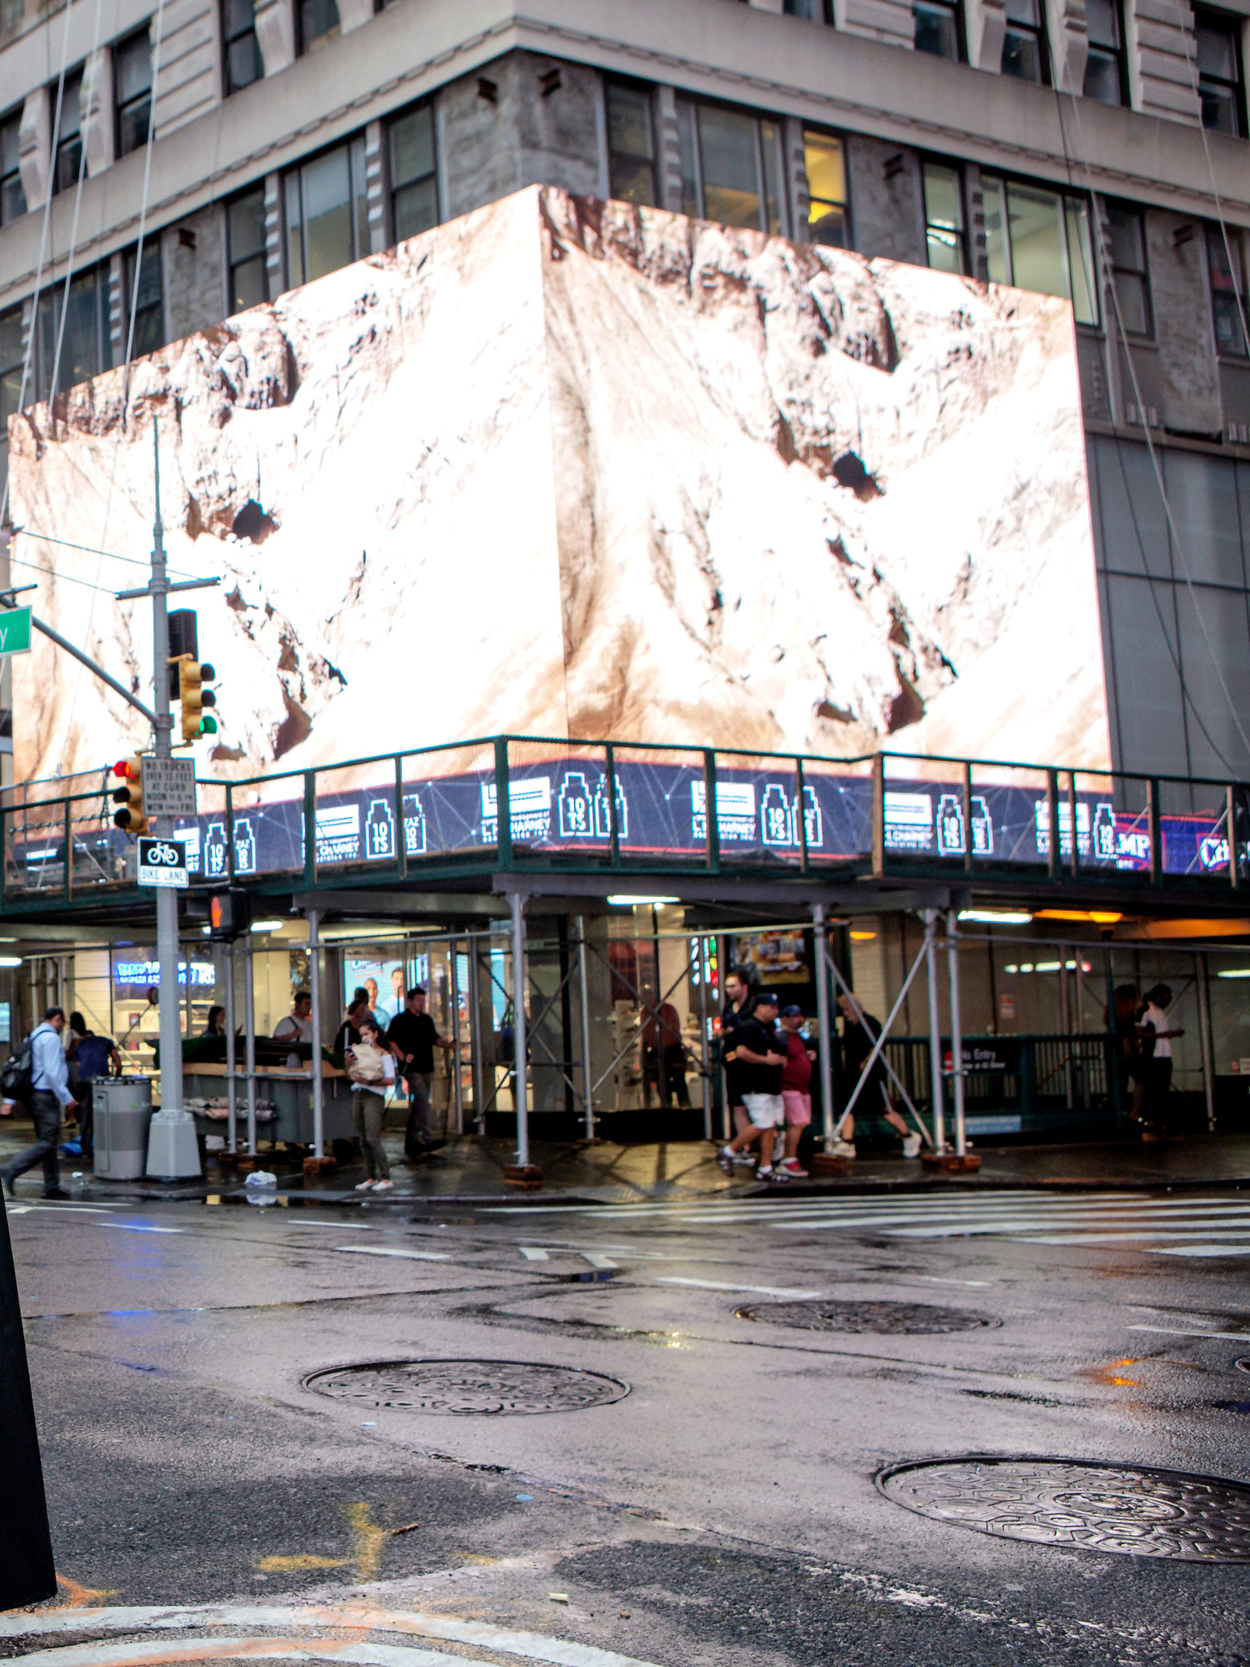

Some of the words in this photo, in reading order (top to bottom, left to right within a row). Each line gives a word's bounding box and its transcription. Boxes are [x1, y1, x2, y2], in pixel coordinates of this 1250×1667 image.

[146, 762, 157, 770] NO
[160, 762, 191, 771] TRUCKS
[152, 782, 160, 790] AT
[164, 782, 186, 792] CURB
[147, 792, 167, 800] NOON
[181, 803, 193, 811] FRI
[566, 797, 585, 812] 10
[768, 808, 784, 822] 10
[372, 822, 388, 837] 10
[509, 818, 551, 834] HARNEY
[211, 844, 224, 857] 10
[373, 837, 388, 854] TS
[210, 857, 224, 872] TS
[142, 868, 160, 879] BIKE
[164, 870, 185, 881] LANE
[974, 1048, 997, 1061] Entry
